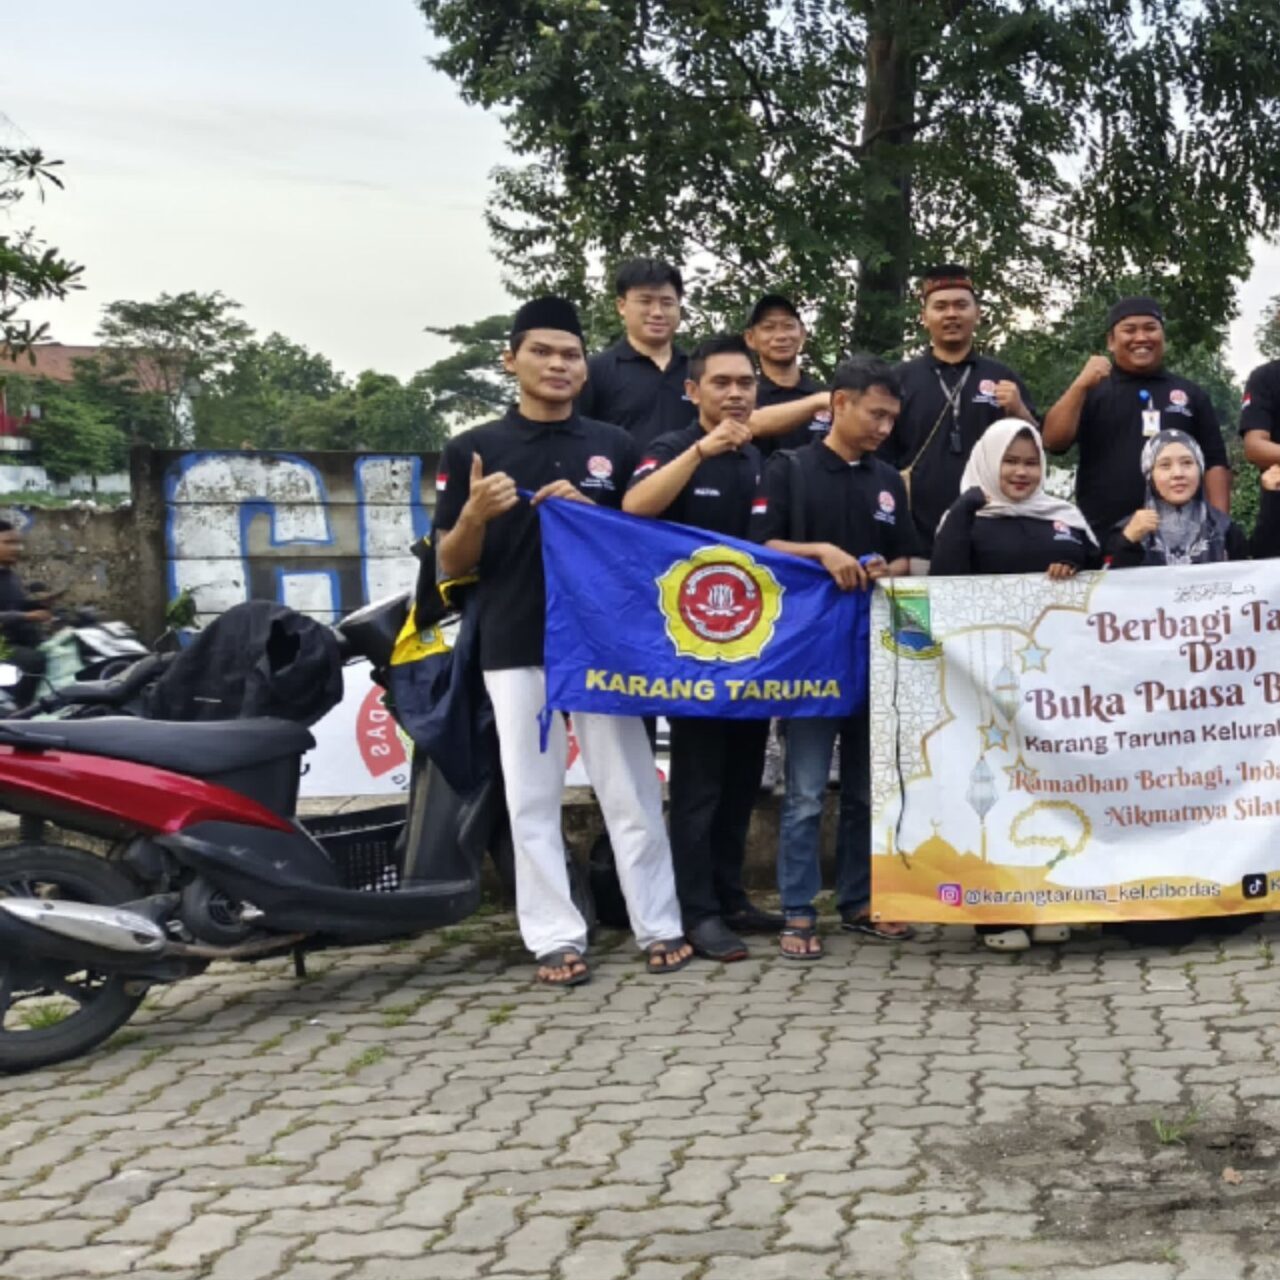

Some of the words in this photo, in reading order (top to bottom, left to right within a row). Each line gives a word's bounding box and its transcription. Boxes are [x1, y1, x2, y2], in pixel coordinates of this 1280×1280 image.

[1086, 605, 1232, 644] Berbagi
[1179, 642, 1258, 673] Dan
[586, 668, 715, 700] KARANG
[724, 679, 841, 700] TARUNA
[1024, 687, 1127, 722] Buka
[1134, 681, 1246, 714] Puasa
[1024, 732, 1109, 755] Karang
[1114, 728, 1197, 749] Taruna
[1011, 770, 1128, 797] Ramadhan
[1134, 763, 1231, 791] Berbagi,
[1105, 799, 1228, 827] Nikmatnya
